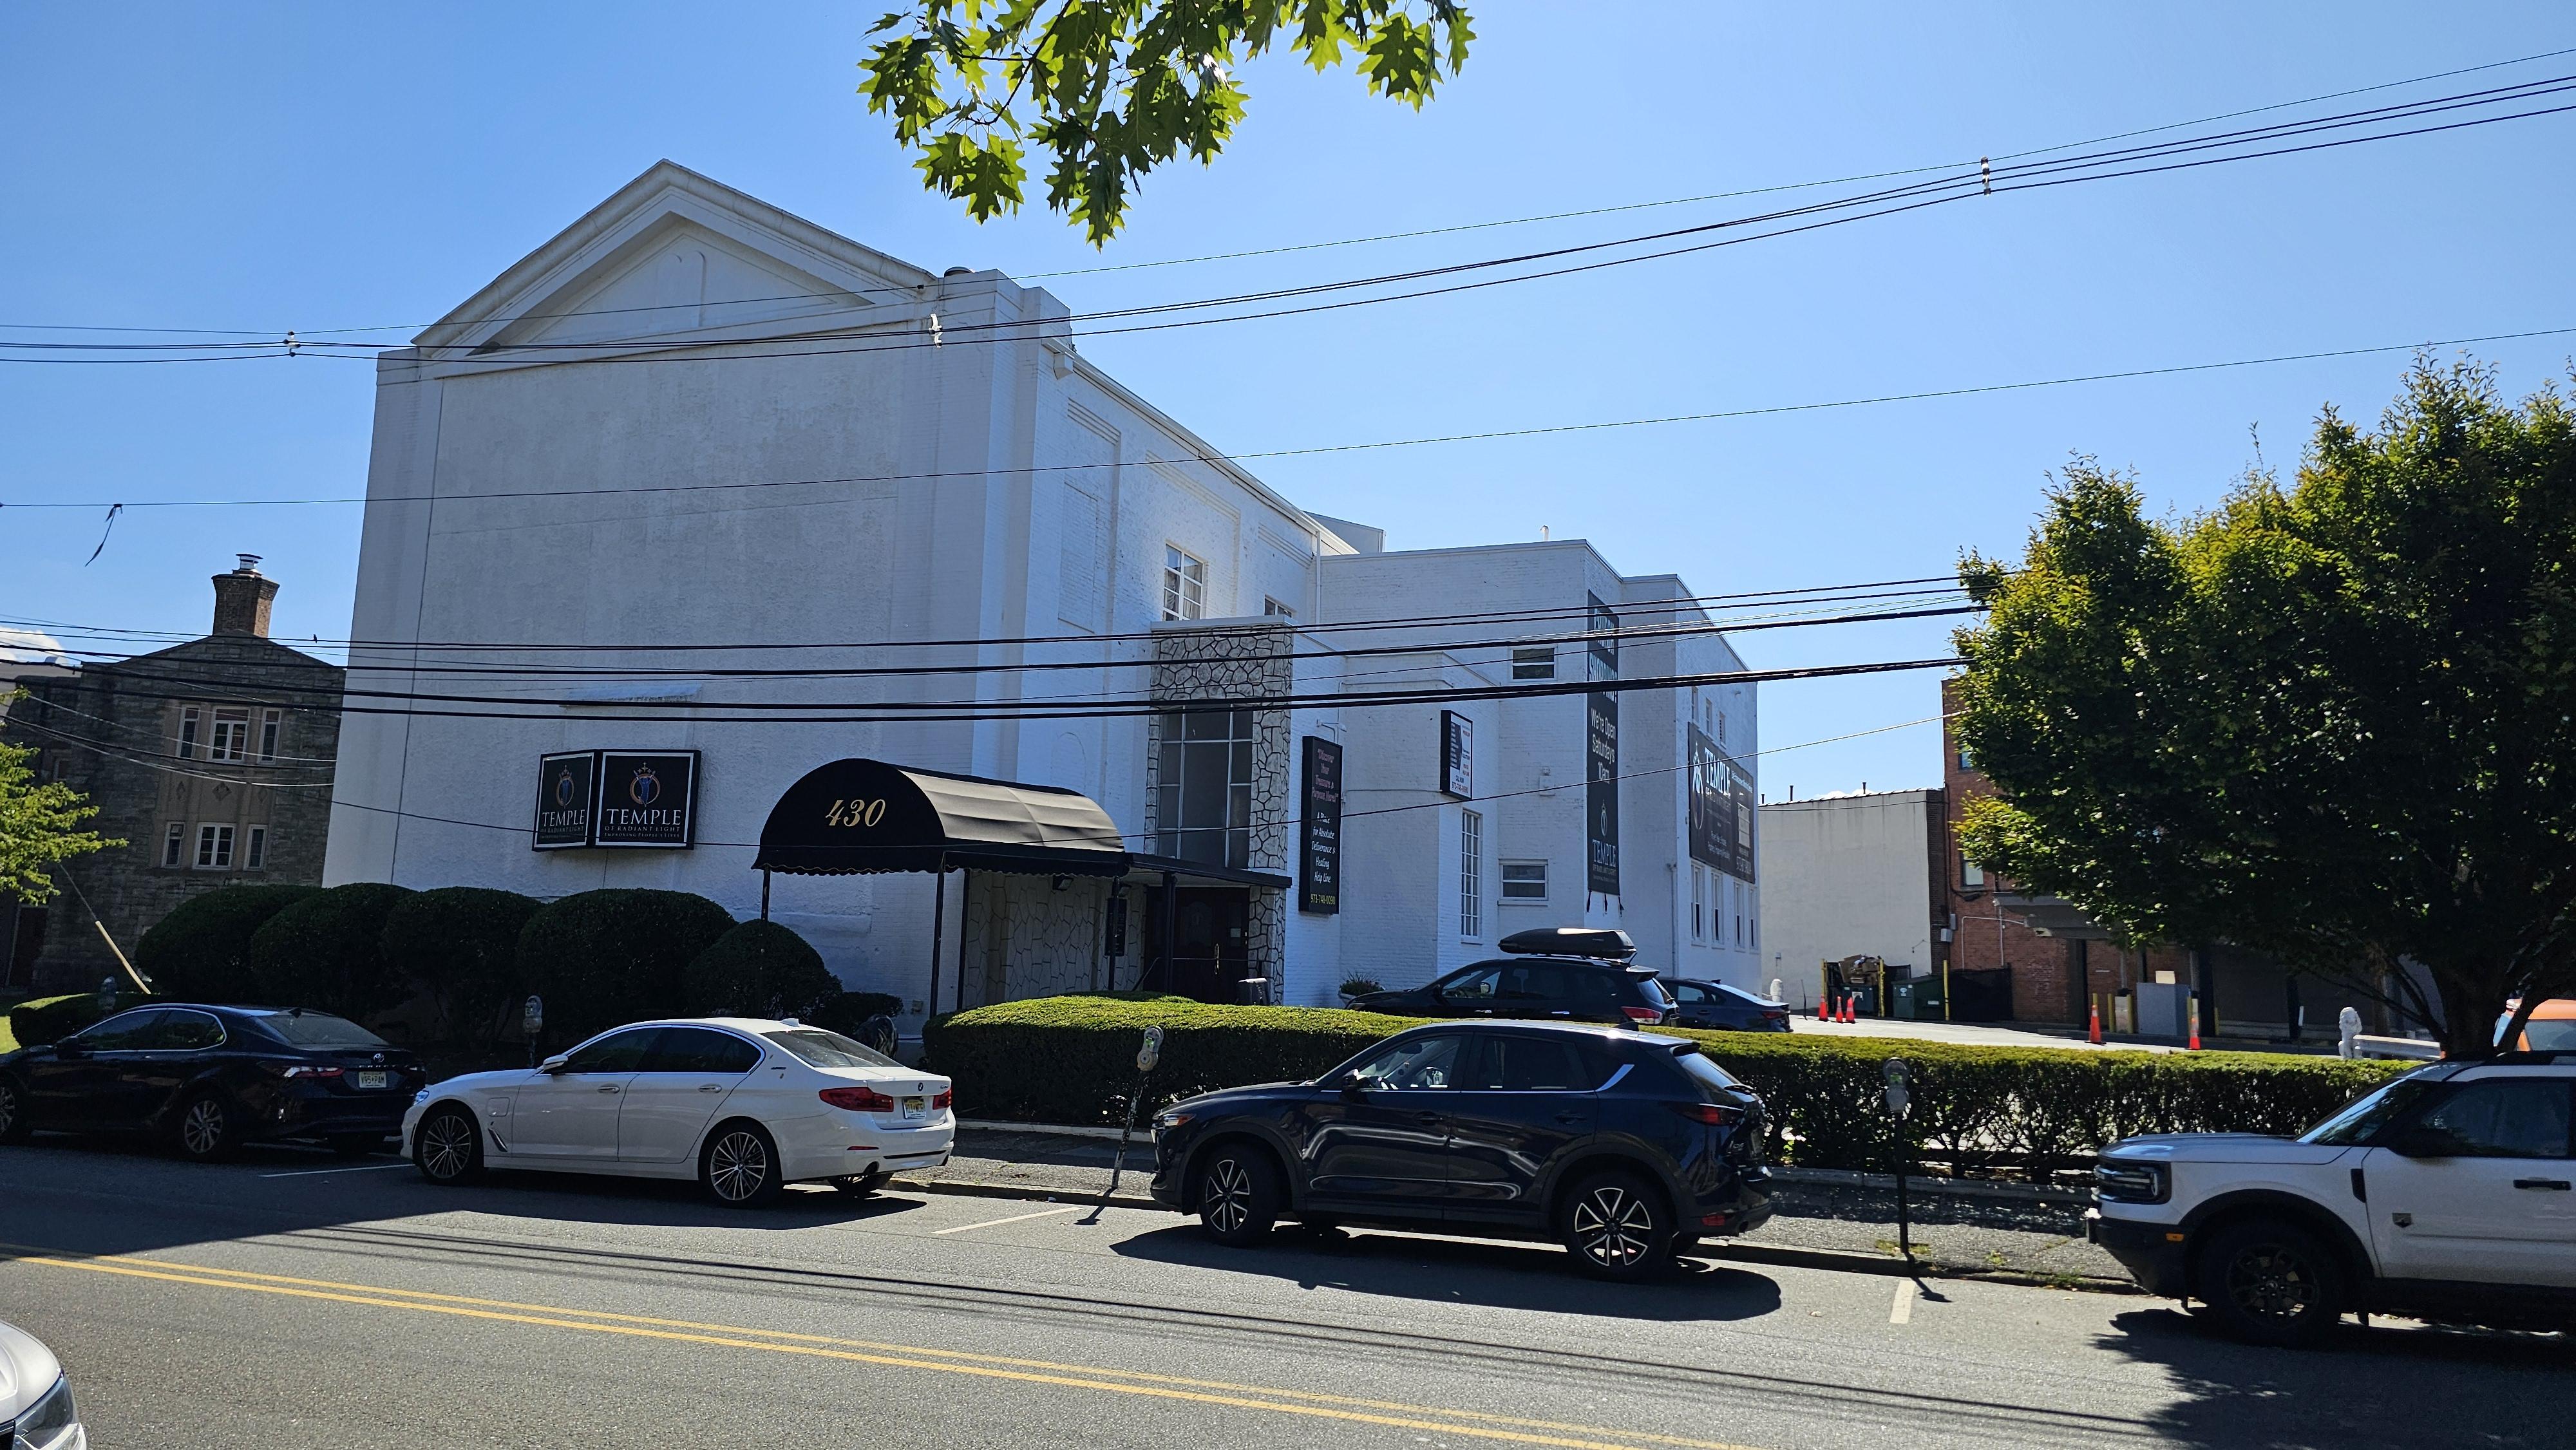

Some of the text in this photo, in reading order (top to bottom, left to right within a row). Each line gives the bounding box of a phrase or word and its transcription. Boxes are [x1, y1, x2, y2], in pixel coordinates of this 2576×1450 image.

[1591, 707, 1616, 740] We're Open
[1592, 733, 1615, 765] Saturdays
[1704, 747, 1731, 796] TEMPLE
[542, 809, 585, 827] TEMPLE
[606, 809, 681, 825] TEMPLE
[825, 799, 886, 827] 430
[1318, 827, 1335, 840] Absolute
[1592, 839, 1616, 867] TEMPLE
[1314, 871, 1331, 883] Help Line
